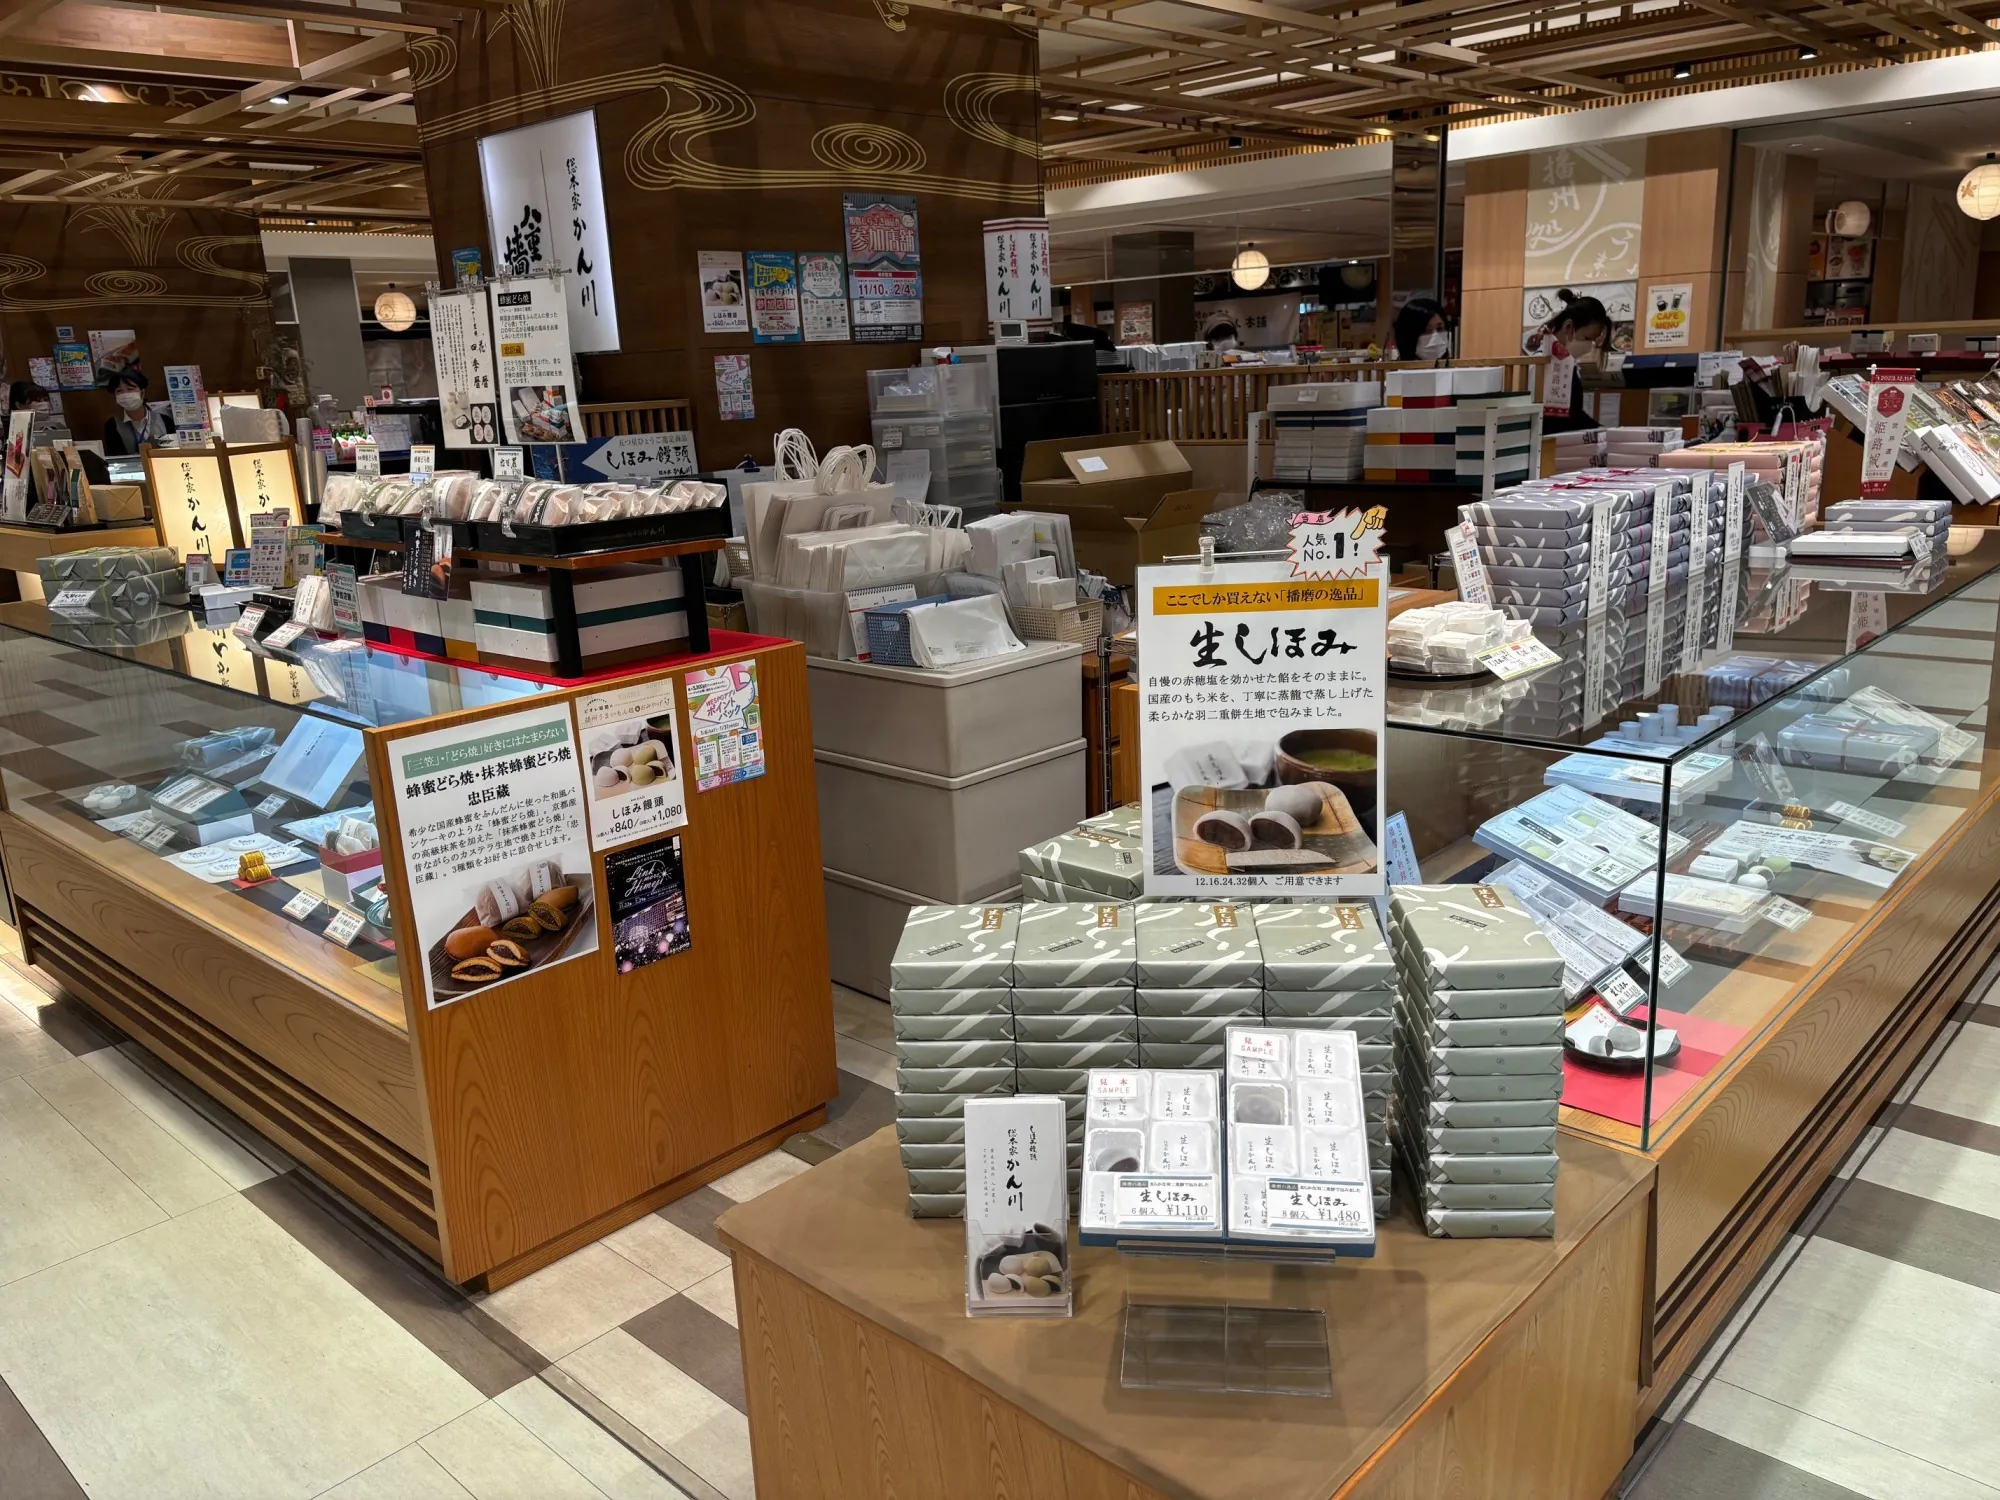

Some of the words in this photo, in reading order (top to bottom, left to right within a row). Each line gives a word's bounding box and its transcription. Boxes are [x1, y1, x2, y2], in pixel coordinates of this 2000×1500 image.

[566, 157, 599, 317] 総本家かん川
[851, 228, 915, 253] 参加店舗
[997, 234, 1010, 319] 総本家かん川
[1029, 232, 1042, 317] 総本家かん川
[1655, 312, 1680, 321] CAFE
[1655, 321, 1680, 330] MENU
[1869, 421, 1887, 468] 姫路城
[606, 445, 691, 470] しほみ饅頭
[181, 462, 212, 557] 総本家かん川
[1302, 513, 1324, 524] 当店
[1303, 533, 1327, 547] 人気
[1166, 587, 1364, 607] ここでしか買えない「播磨の逸品」
[1190, 621, 1358, 669] 生しほみ
[1148, 670, 1368, 688] 自慢の赤穂塩を効かせた餡をそのままに。
[1148, 687, 1374, 705] 国産のもち米を、丁寧に蒸籠で蒸し上げた
[707, 697, 736, 717] ポイント
[718, 705, 741, 722] パック
[406, 726, 566, 772] 「三笠」・「どら焼」好きにはたまらない
[405, 747, 572, 800] 蜂蜜どら焼・抹茶蜂蜜どら焼
[467, 784, 511, 807] 忠臣蔵
[408, 787, 577, 838] 希少な国産蜂蜜をふんだんに使った和風パ
[612, 795, 664, 820] しほみ饅頭
[410, 797, 577, 849] ンケーキのような「蜂蜜どら焼」。京都産
[411, 812, 574, 861] の高級抹茶を加えた「抹茶蜂蜜どら焼」。
[414, 819, 580, 874] 昔ながらのカステラ生地で焼き上げた「忠
[625, 861, 655, 883] Link
[1195, 876, 1268, 887] 12.16.24.32個入
[1274, 875, 1343, 887] ご用意できます
[1240, 1045, 1274, 1056] SAMPLE
[1244, 1036, 1273, 1047] 見本
[1097, 1086, 1131, 1094] SAMPLE
[1099, 1078, 1128, 1086] 見本
[1006, 1128, 1023, 1212] 総本家かん川
[1139, 1188, 1197, 1203] 生しほみ
[1290, 1192, 1349, 1207] 生しほみ
[1131, 1206, 1158, 1216] 6個入
[1166, 1204, 1208, 1217] ¥1,110
[1282, 1209, 1309, 1220] 8個入
[1317, 1208, 1361, 1222] ¥1,480
